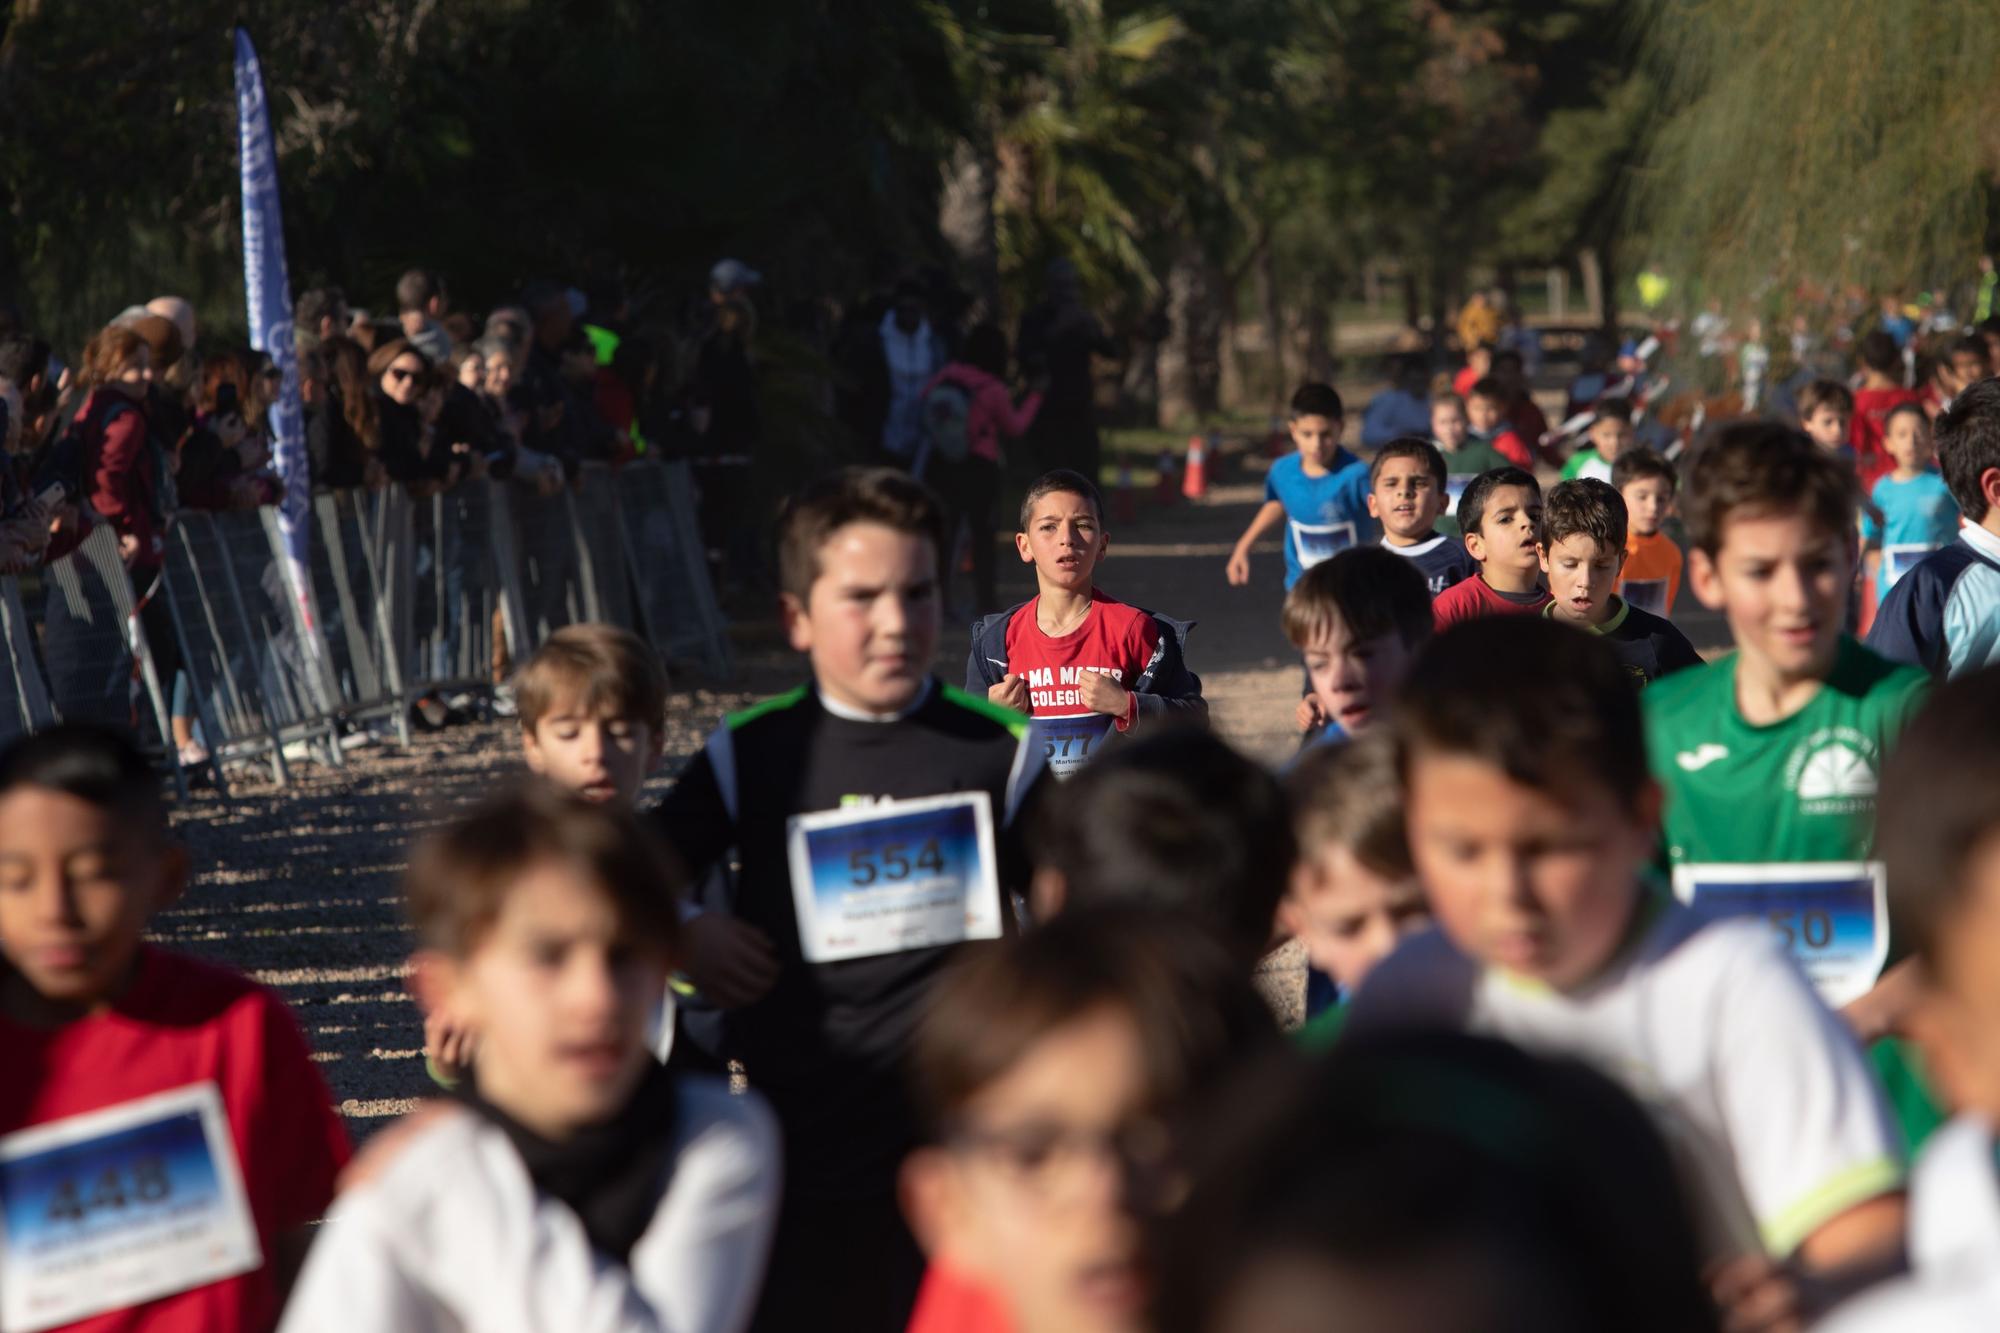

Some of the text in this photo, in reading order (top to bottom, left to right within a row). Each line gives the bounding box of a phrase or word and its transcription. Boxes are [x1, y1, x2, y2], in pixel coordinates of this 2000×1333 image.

[1030, 690, 1083, 707] COLEGI
[1043, 735, 1092, 758] 577
[849, 836, 945, 888] 554
[1766, 908, 1833, 949] 50
